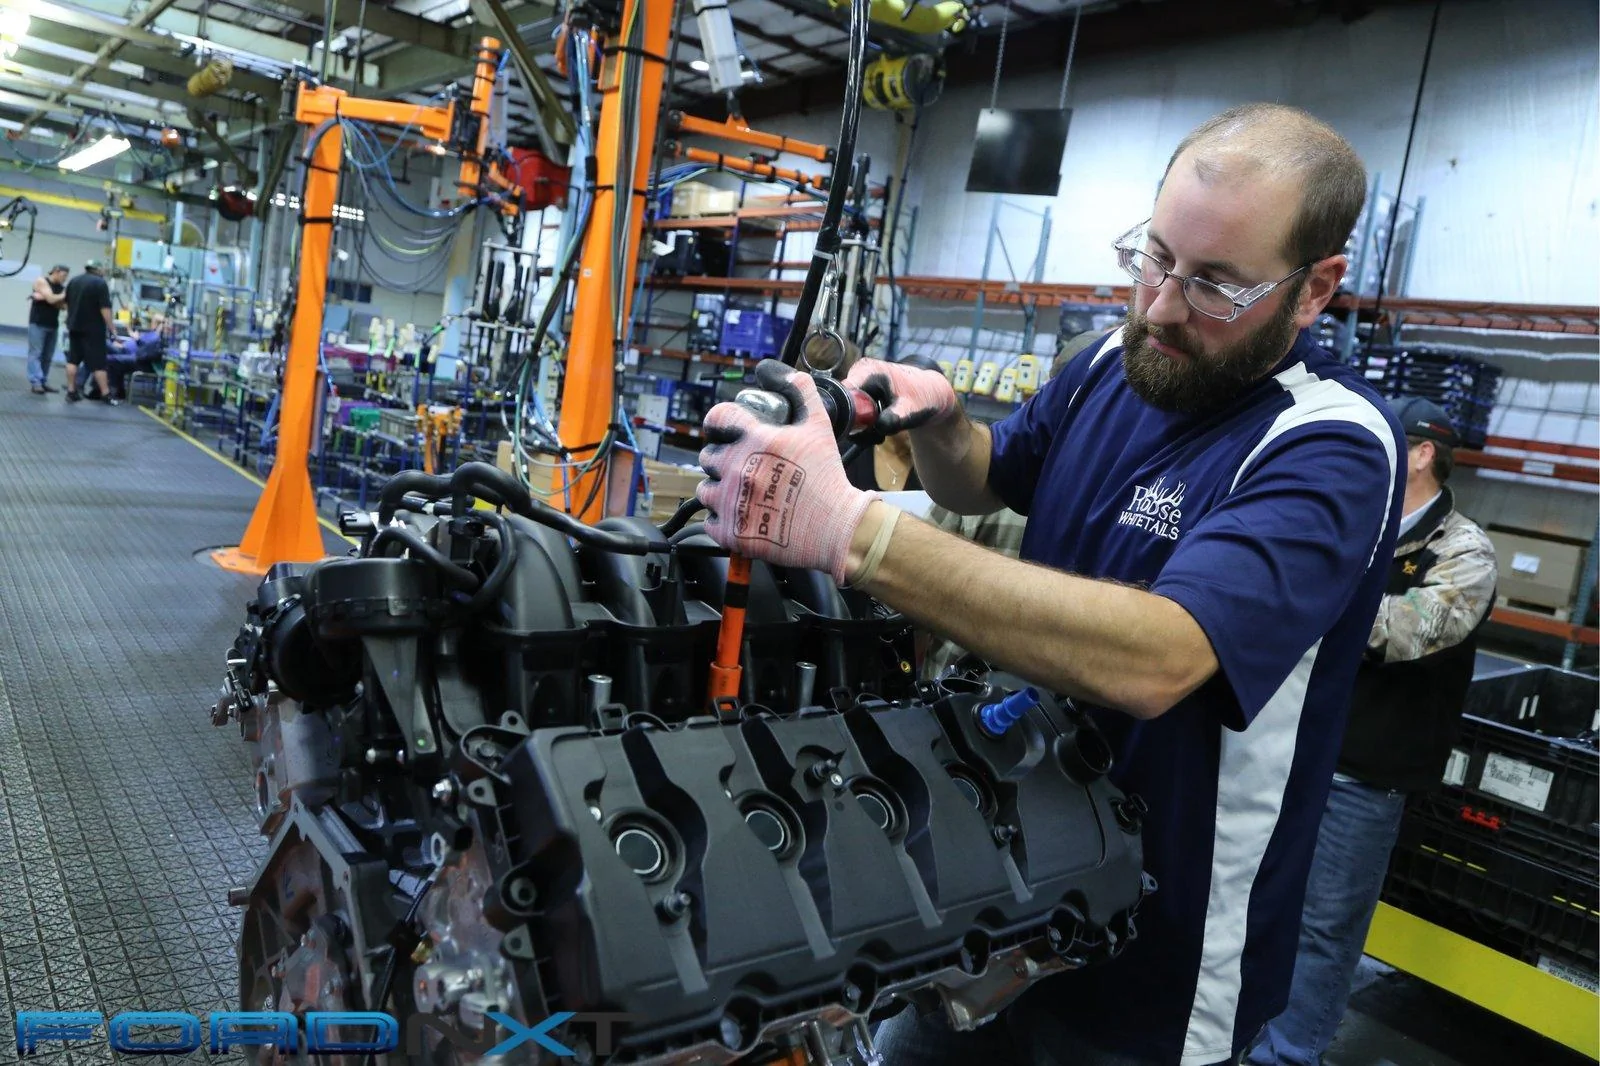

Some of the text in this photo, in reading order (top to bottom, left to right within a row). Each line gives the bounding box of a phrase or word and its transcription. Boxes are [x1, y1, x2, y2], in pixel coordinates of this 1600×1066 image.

[763, 462, 786, 502] Tach
[758, 512, 771, 536] De
[1118, 510, 1180, 541] WHITETAILS
